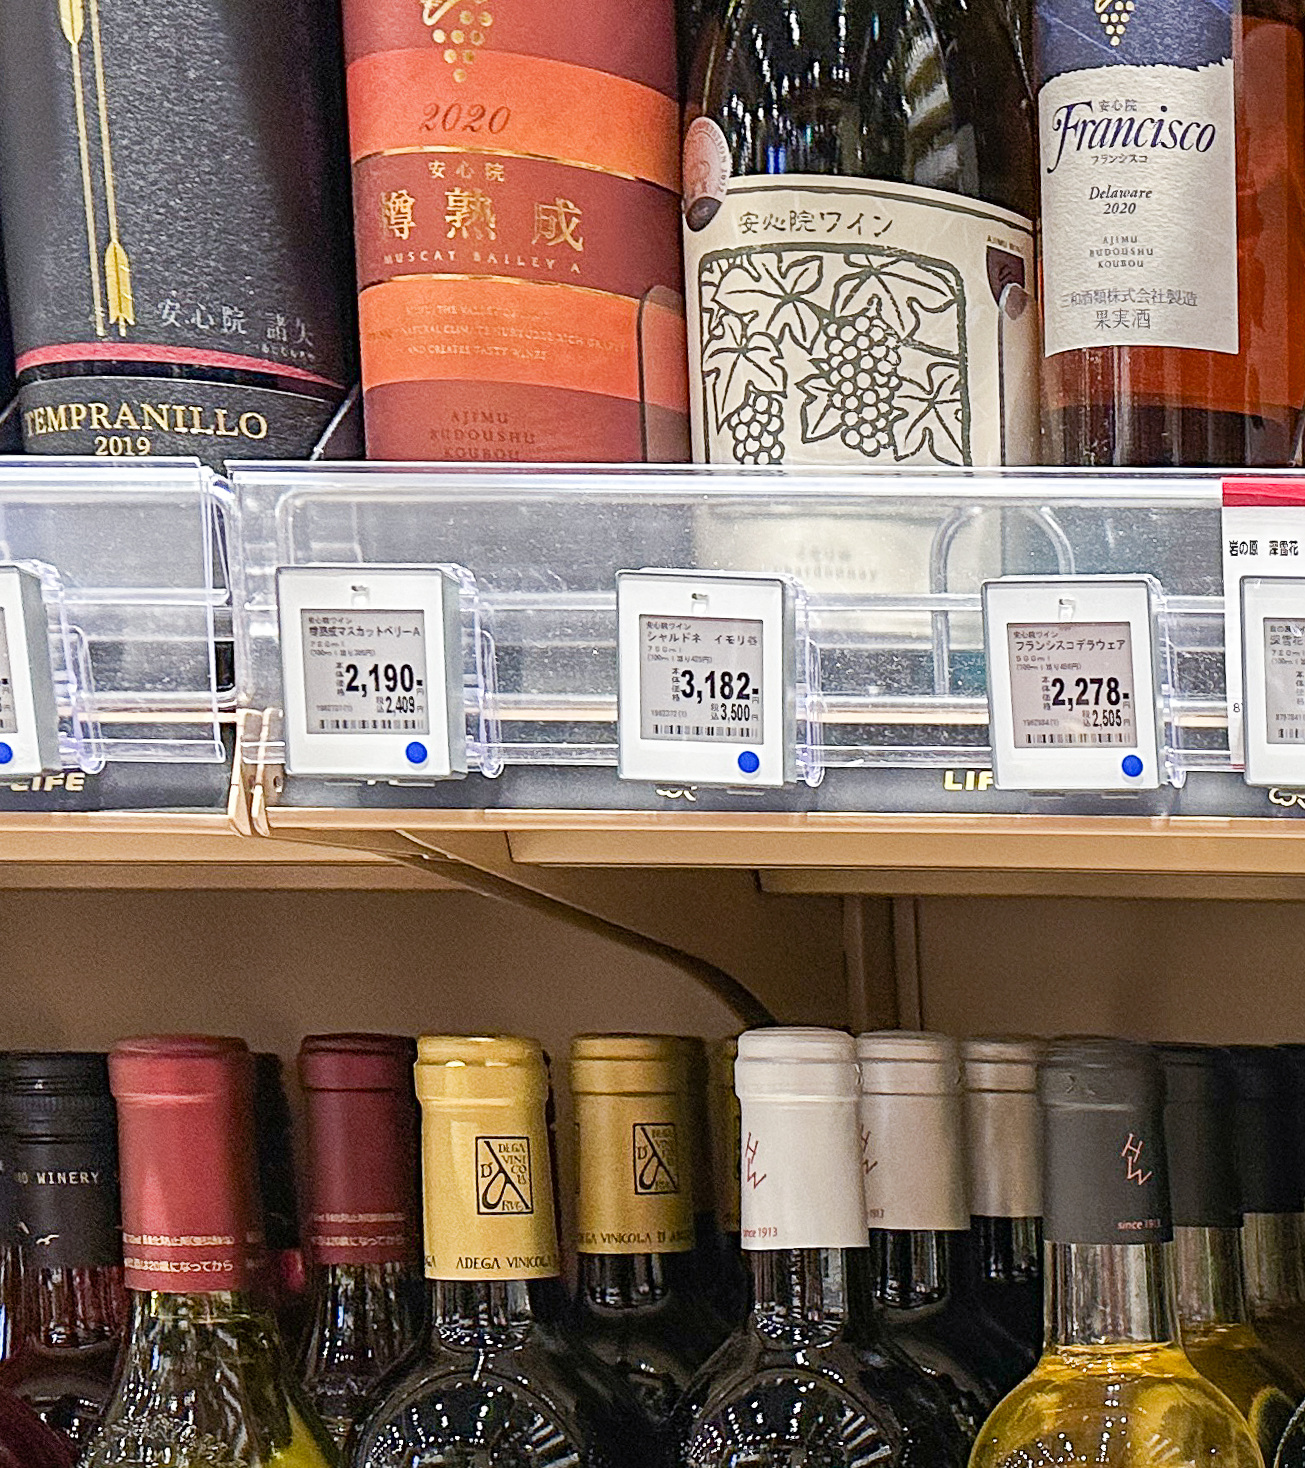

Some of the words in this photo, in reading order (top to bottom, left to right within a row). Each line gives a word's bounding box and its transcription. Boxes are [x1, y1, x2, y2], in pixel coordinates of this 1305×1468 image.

[418, 102, 512, 134] 2020
[1047, 100, 1216, 174] Francisco
[428, 160, 504, 182] 安心院
[1089, 185, 1152, 202] Delaware
[1103, 202, 1137, 215] 2020
[381, 188, 584, 252] 樽熟成
[738, 210, 894, 237] 安心院ワイン
[1094, 308, 1150, 330] 果実酒
[23, 401, 268, 440] TEMPRANILLO
[95, 436, 150, 457] 2019
[346, 663, 414, 698] 2,190
[680, 670, 751, 704] 3,182
[1051, 676, 1120, 711] 2,278
